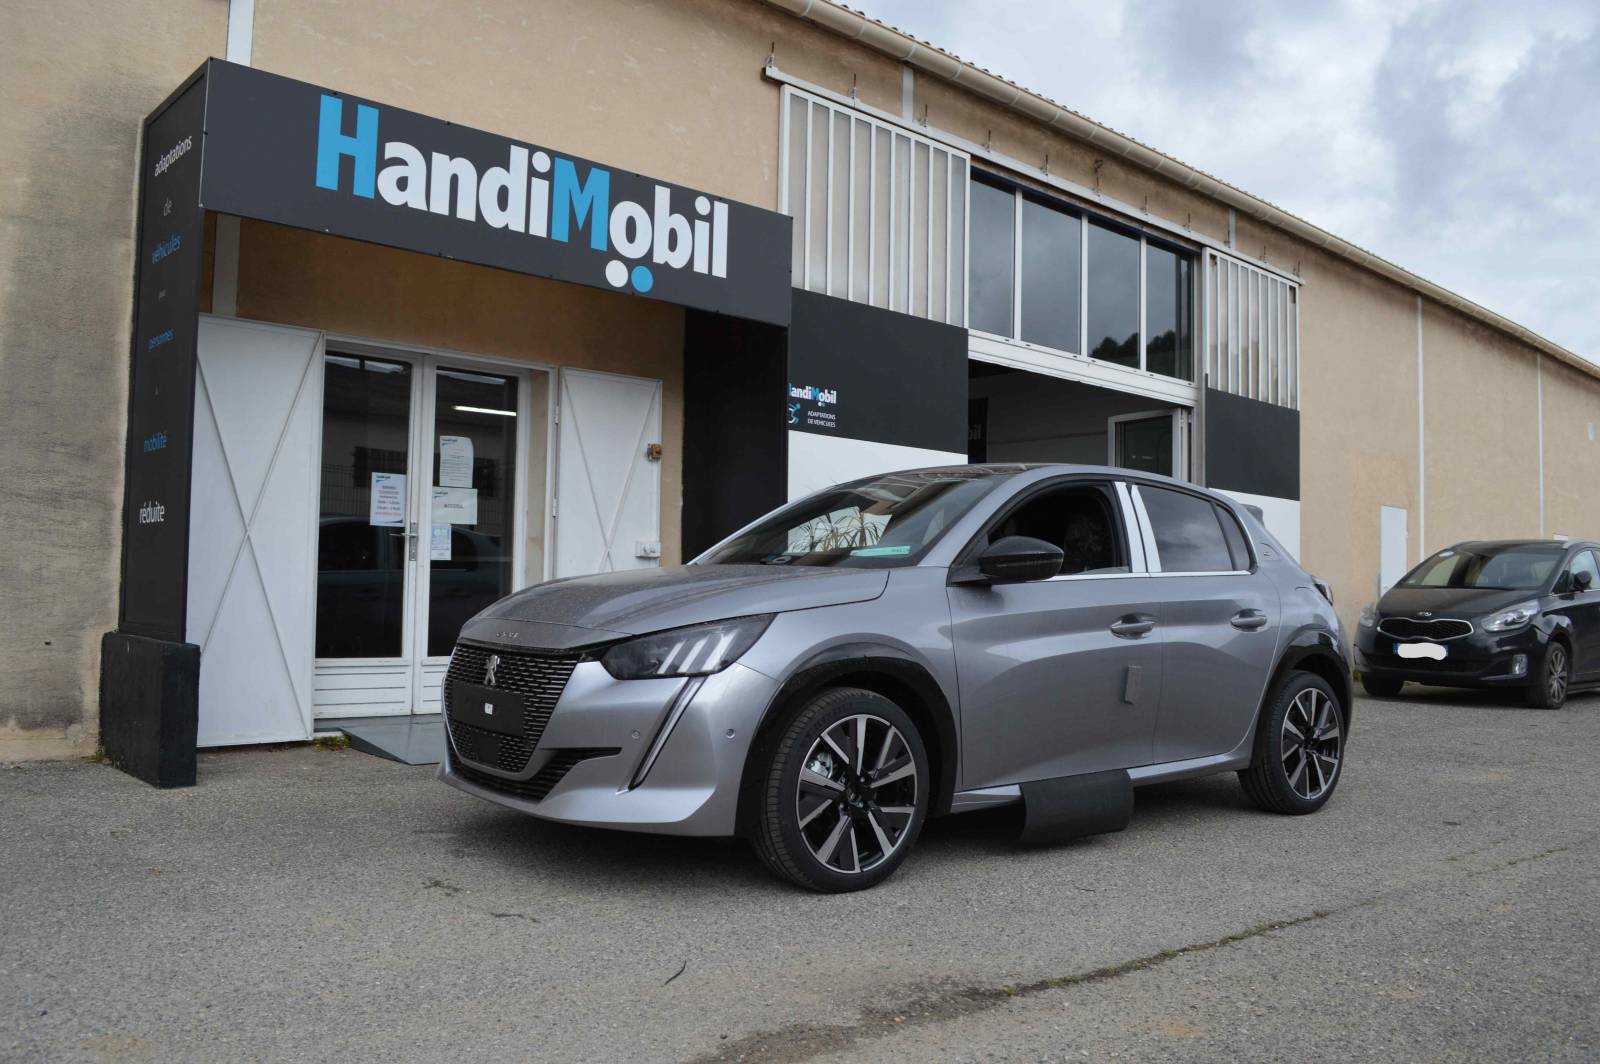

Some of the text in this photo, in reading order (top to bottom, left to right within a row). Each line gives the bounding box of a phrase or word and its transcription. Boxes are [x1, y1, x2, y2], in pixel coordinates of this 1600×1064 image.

[154, 135, 192, 177] adaptations
[316, 94, 728, 278] HandiMobil
[139, 500, 165, 524] réduite
